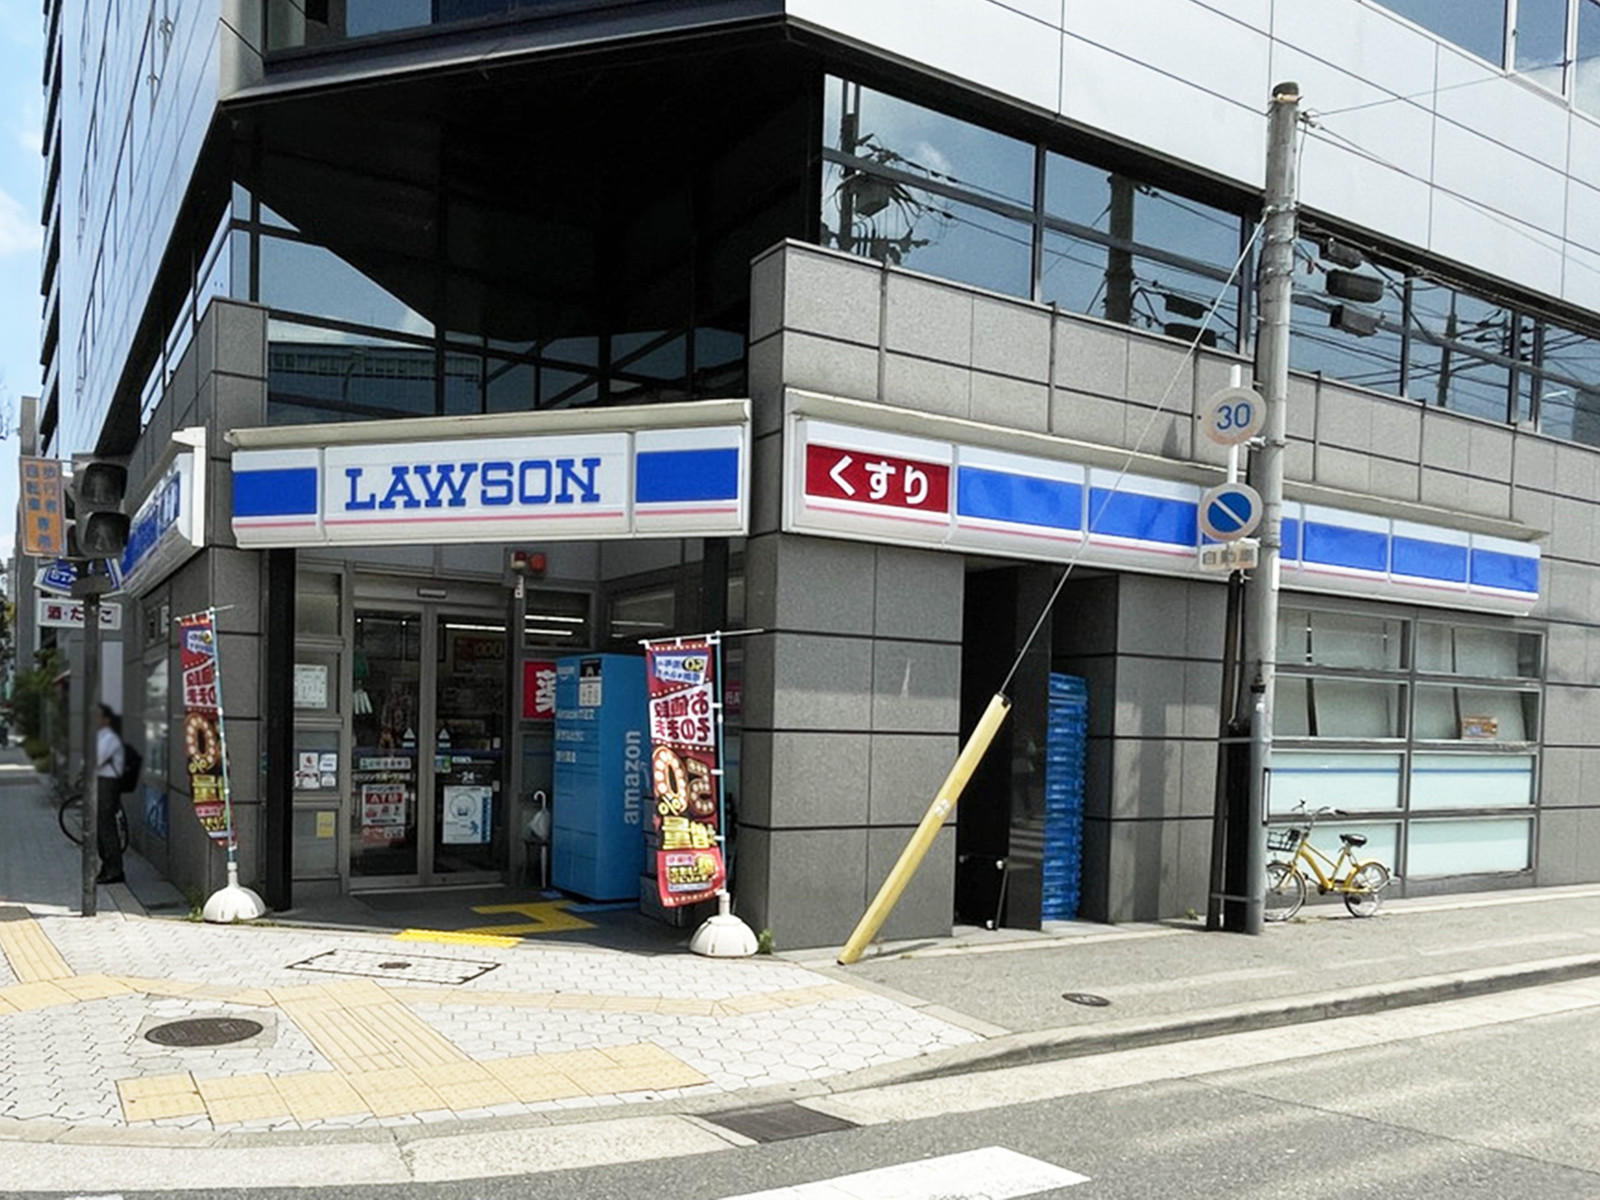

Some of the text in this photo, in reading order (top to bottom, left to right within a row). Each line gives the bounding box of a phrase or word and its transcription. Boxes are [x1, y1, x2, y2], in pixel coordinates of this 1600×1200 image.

[1216, 403, 1251, 430] 30
[345, 457, 601, 511] LAWSON
[829, 455, 928, 505] くすり
[47, 605, 113, 623] 酒・たこ
[624, 730, 641, 825] amazon
